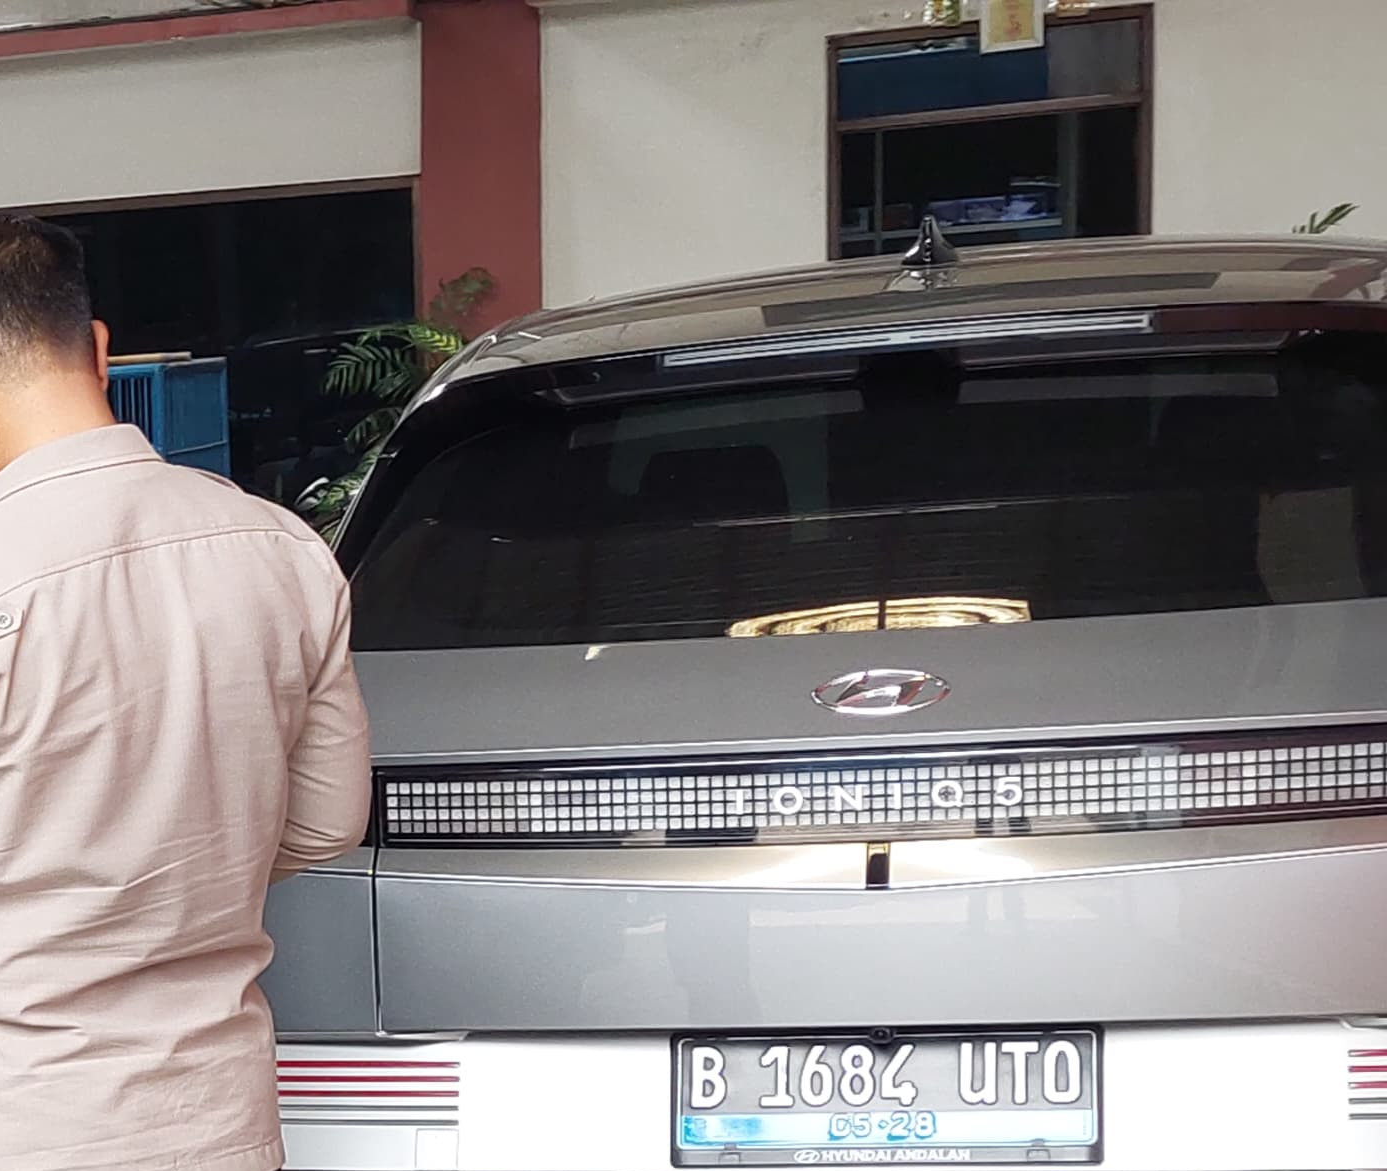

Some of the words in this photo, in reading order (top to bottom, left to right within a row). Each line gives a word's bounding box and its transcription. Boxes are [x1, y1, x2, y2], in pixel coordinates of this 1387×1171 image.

[734, 780, 965, 815] IONIQ
[994, 776, 1023, 807] 5
[690, 1045, 727, 1109] B
[758, 1043, 919, 1109] 1684
[958, 1040, 1083, 1106] UTO
[821, 1150, 891, 1162] HYUNDAI
